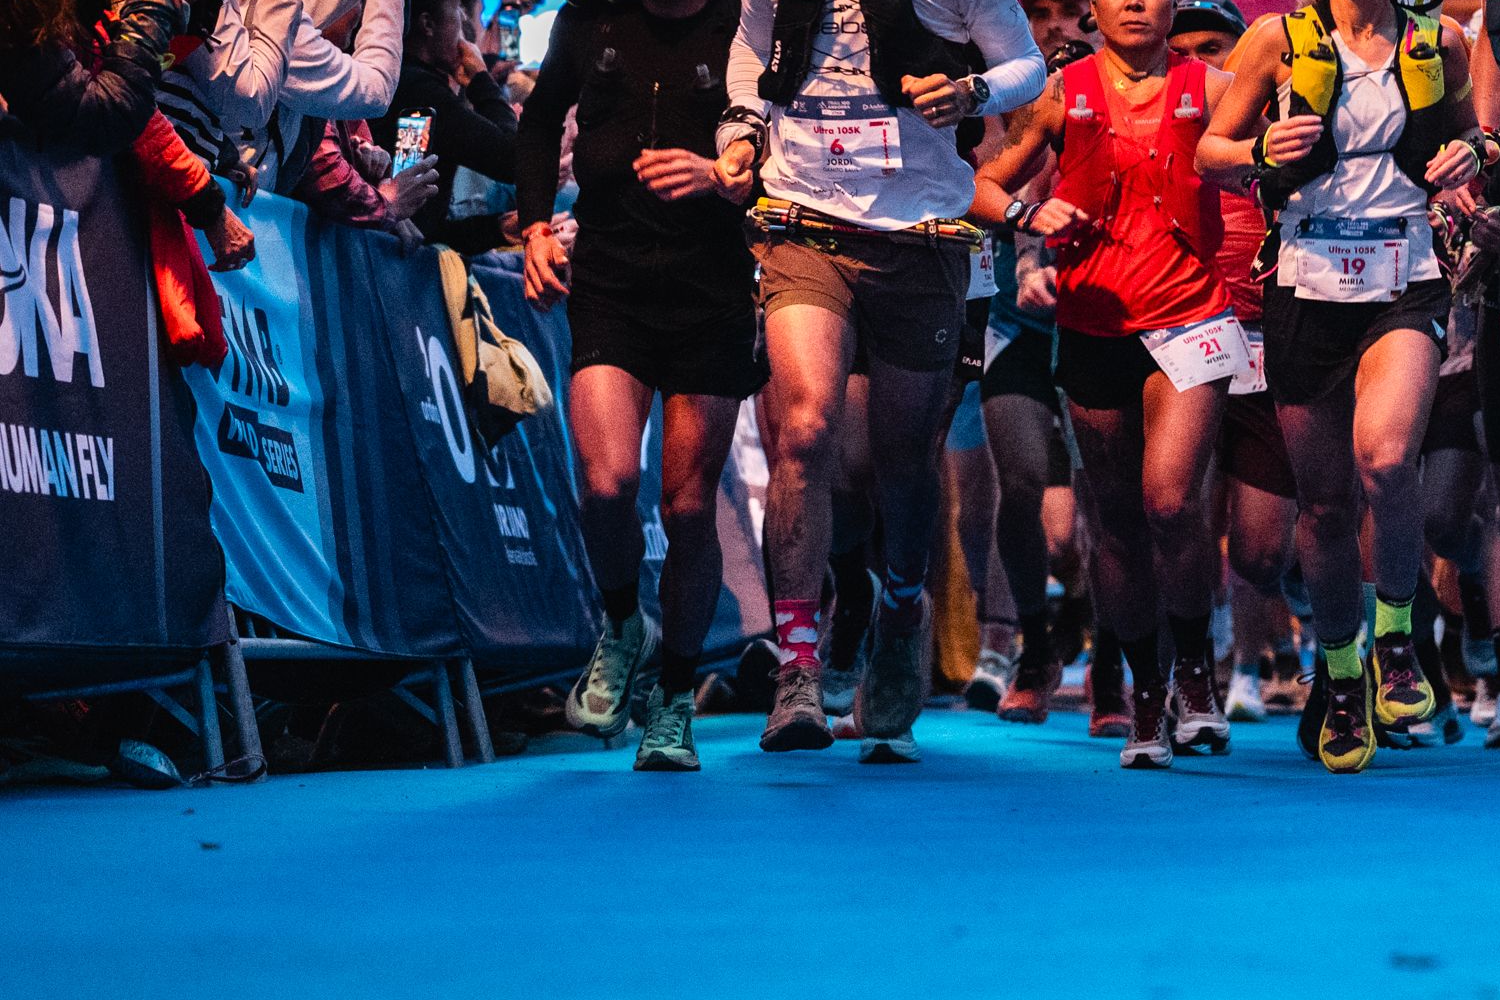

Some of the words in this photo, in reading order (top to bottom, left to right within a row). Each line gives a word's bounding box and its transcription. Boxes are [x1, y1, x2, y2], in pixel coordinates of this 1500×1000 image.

[813, 125, 834, 136] Ultra
[837, 126, 861, 135] 105K
[830, 138, 845, 156] 6
[1328, 245, 1351, 254] Ultra
[1354, 246, 1376, 254] 105K
[1341, 257, 1366, 275] 19
[0, 197, 105, 388] KA
[1182, 334, 1204, 345] Ultra
[1199, 337, 1222, 357] 21
[75, 433, 115, 501] FLY
[261, 436, 299, 481] SERIES
